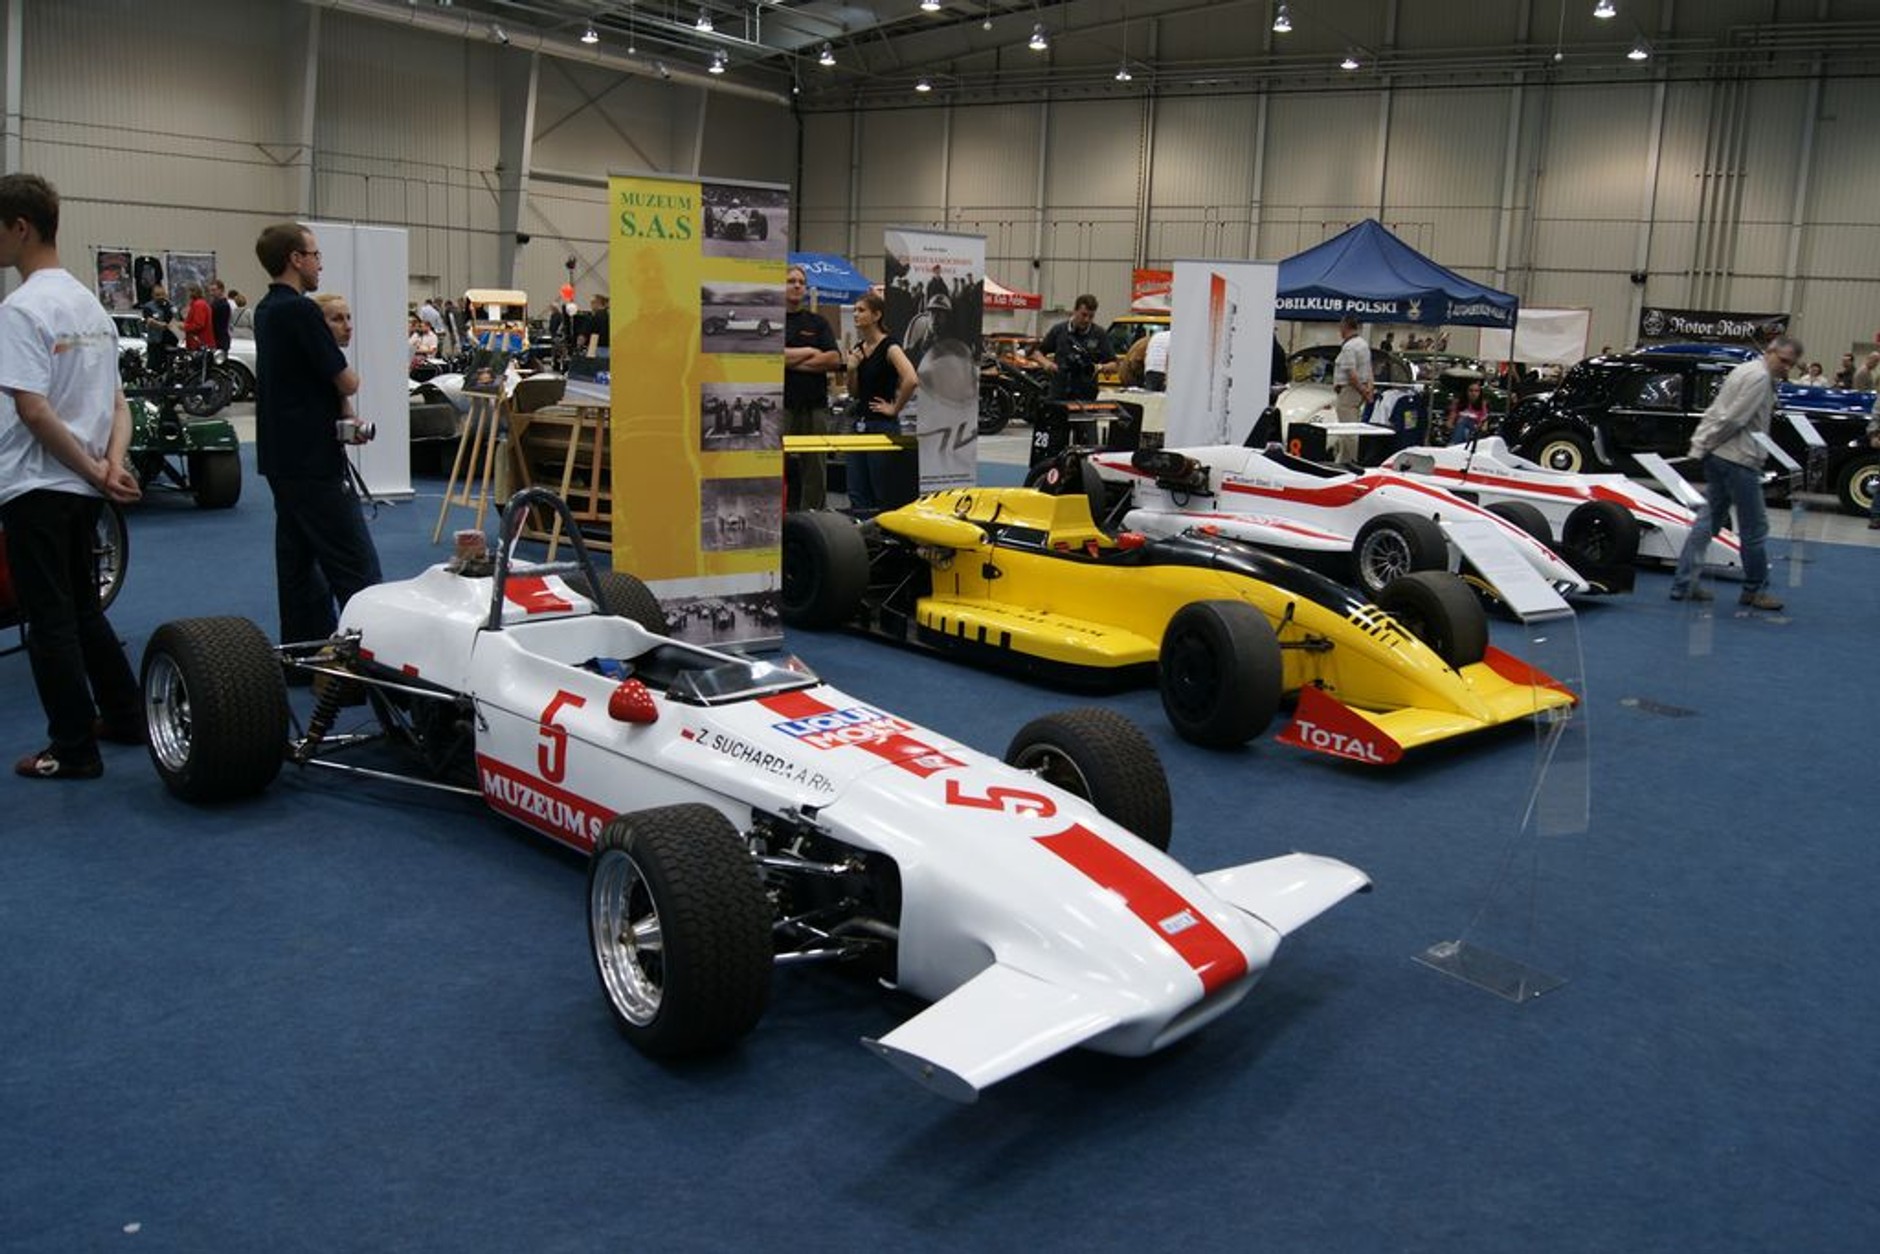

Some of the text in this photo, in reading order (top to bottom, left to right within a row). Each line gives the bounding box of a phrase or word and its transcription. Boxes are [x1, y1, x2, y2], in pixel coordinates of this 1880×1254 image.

[620, 192, 691, 210] MUZEUM
[620, 211, 691, 240] S.A.S
[1274, 297, 1397, 314] OBILKLUB POLSKI
[1034, 431, 1050, 448] 28
[1290, 438, 1301, 457] 8
[538, 689, 587, 784] 5
[1296, 720, 1383, 762] TOTAL
[695, 729, 708, 746] Z.
[711, 734, 794, 780] SUCHARDA
[482, 769, 588, 840] MUZEUM
[946, 779, 1057, 818] 5
